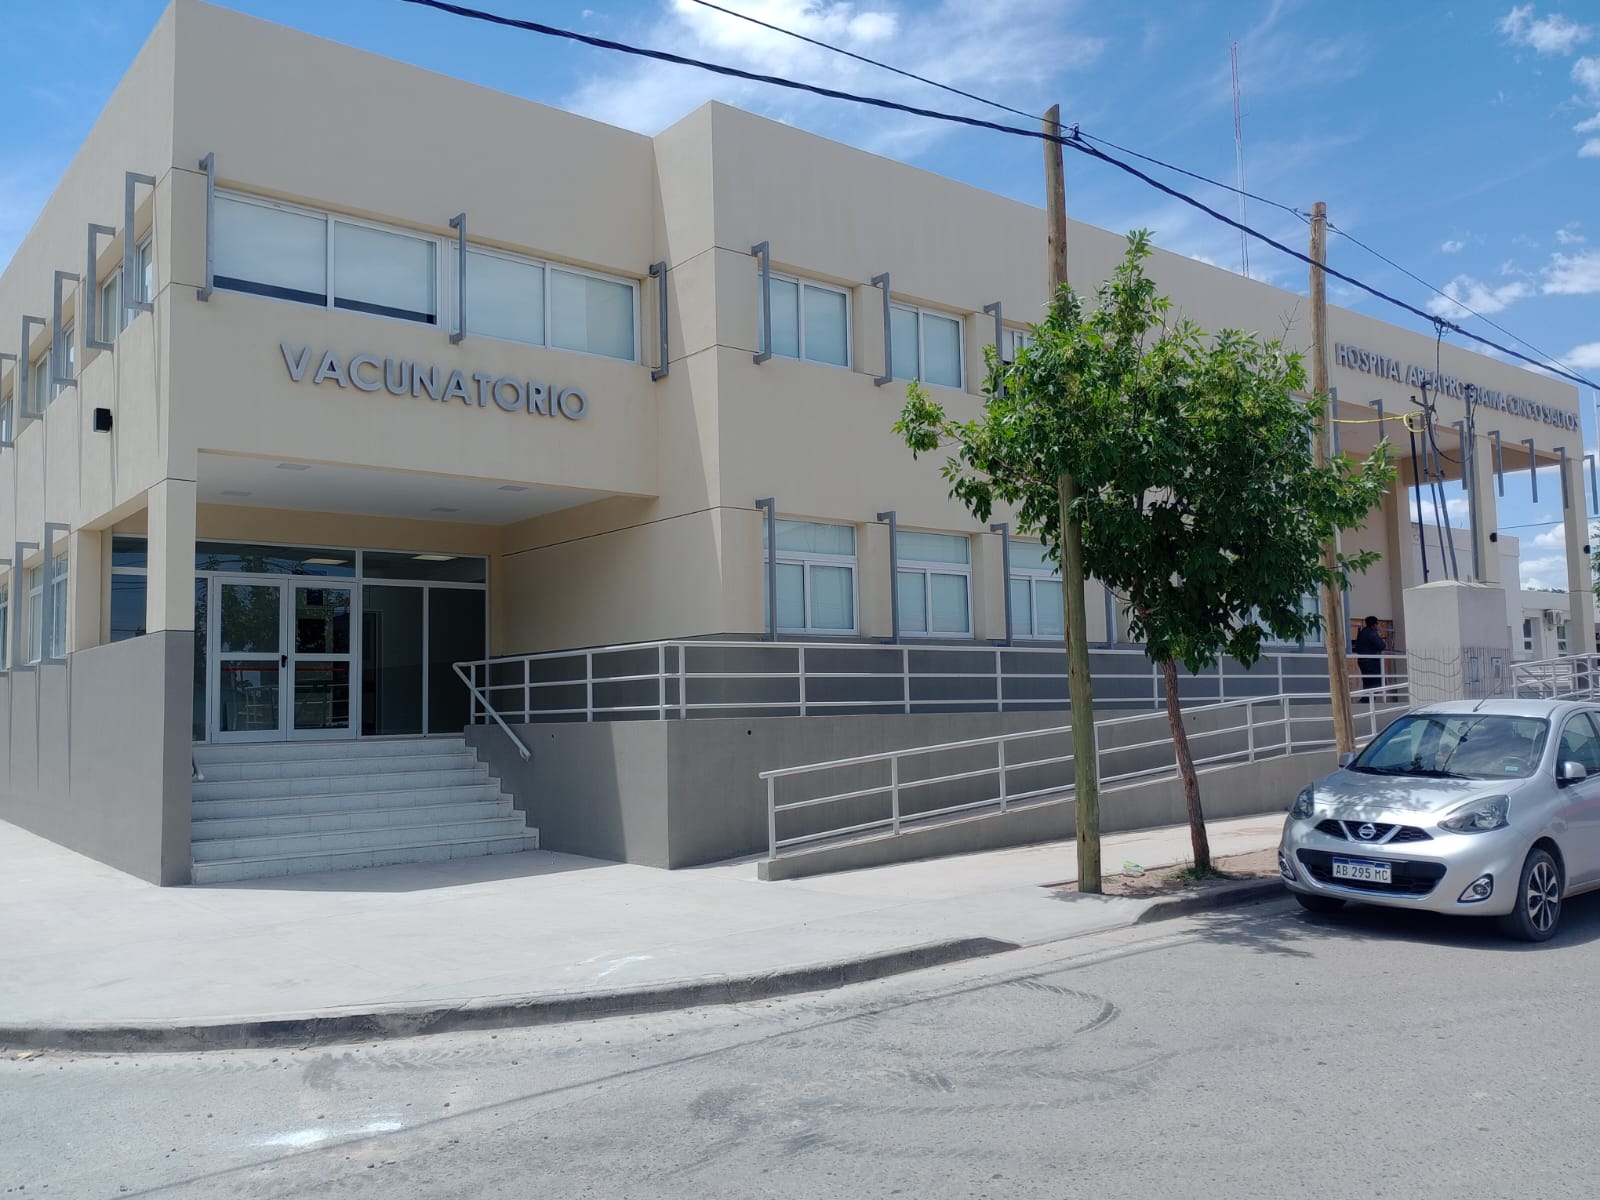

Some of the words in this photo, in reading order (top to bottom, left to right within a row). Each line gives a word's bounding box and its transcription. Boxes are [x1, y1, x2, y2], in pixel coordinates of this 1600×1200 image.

[280, 343, 588, 420] VACUNATORIO
[1335, 343, 1405, 383] HOSPITAL
[1506, 394, 1541, 420] CINCO
[1336, 865, 1348, 876] AB
[1352, 866, 1371, 879] 295
[1375, 869, 1388, 880] MC
